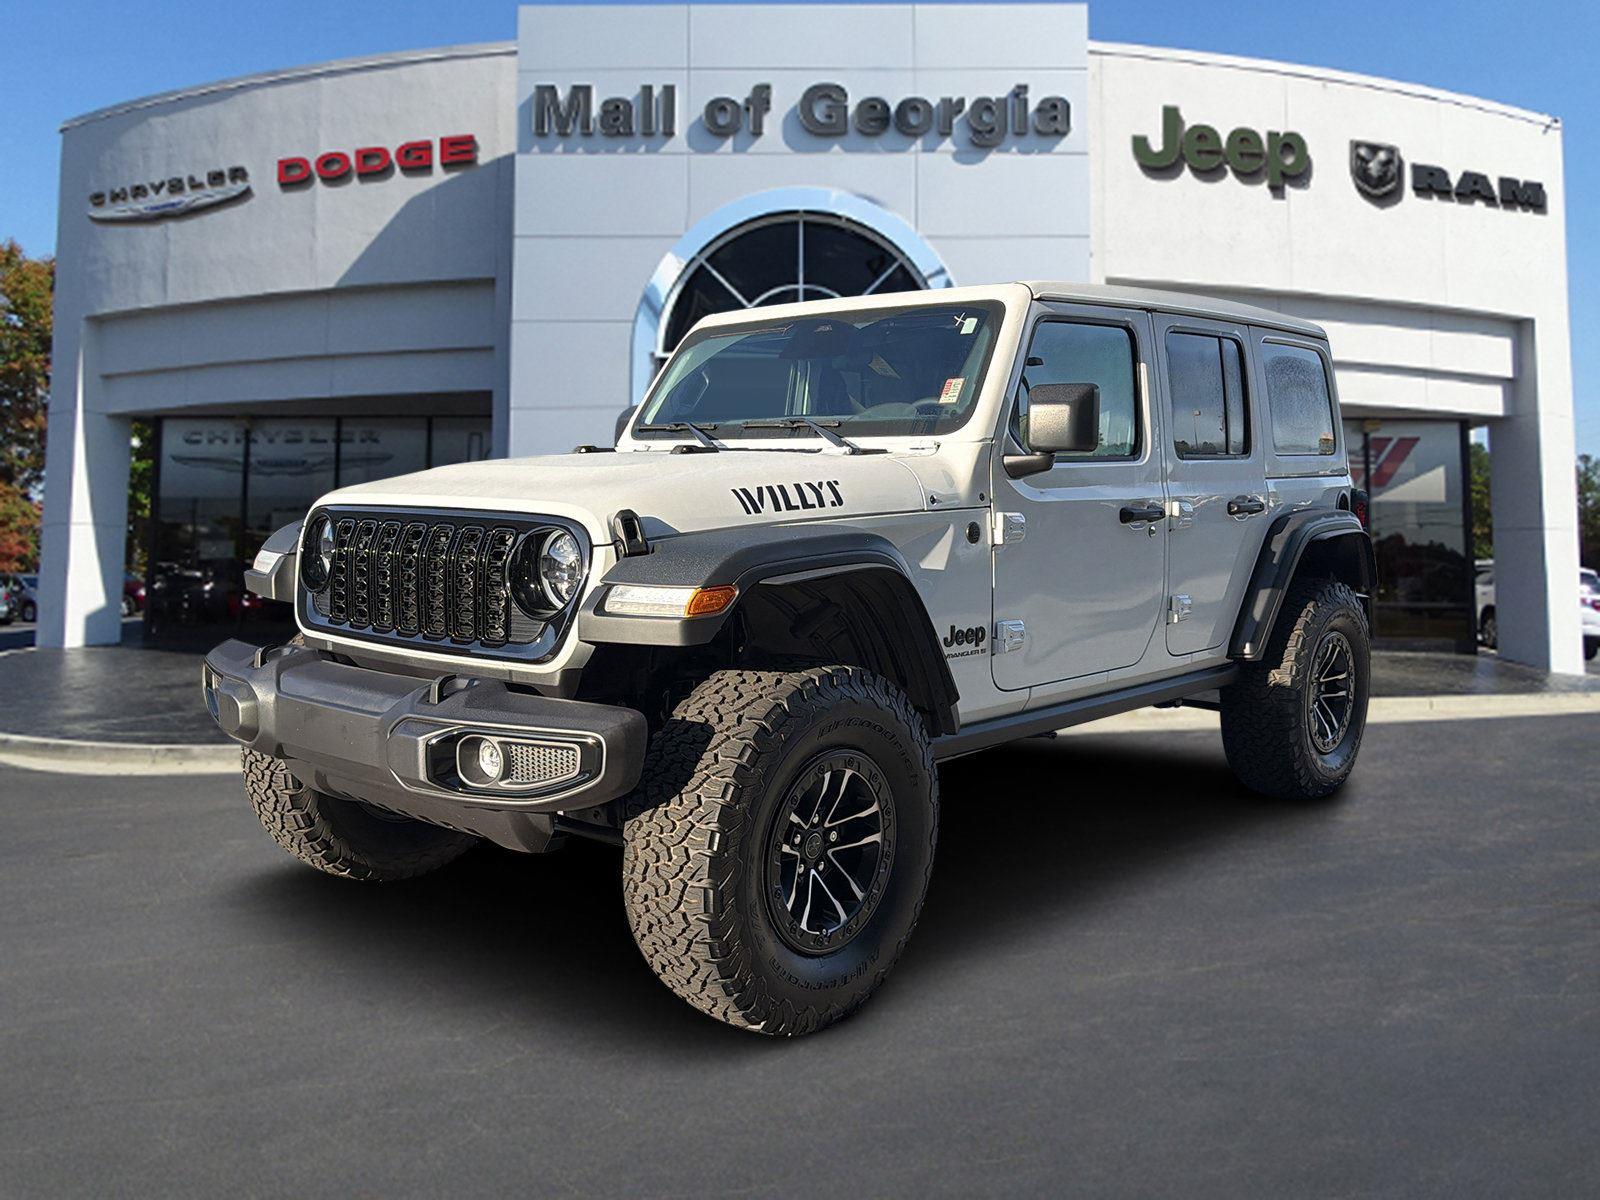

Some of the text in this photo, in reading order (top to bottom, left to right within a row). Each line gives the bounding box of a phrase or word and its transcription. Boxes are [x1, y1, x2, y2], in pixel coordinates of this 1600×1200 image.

[532, 82, 1073, 148] Mall of Georgia
[277, 134, 477, 186] DODGE
[1131, 104, 1309, 188] Jeep
[90, 165, 250, 207] CHRYSLER
[1410, 162, 1546, 213] RAM
[731, 480, 844, 515] WILLYS
[943, 625, 987, 648] Jeep
